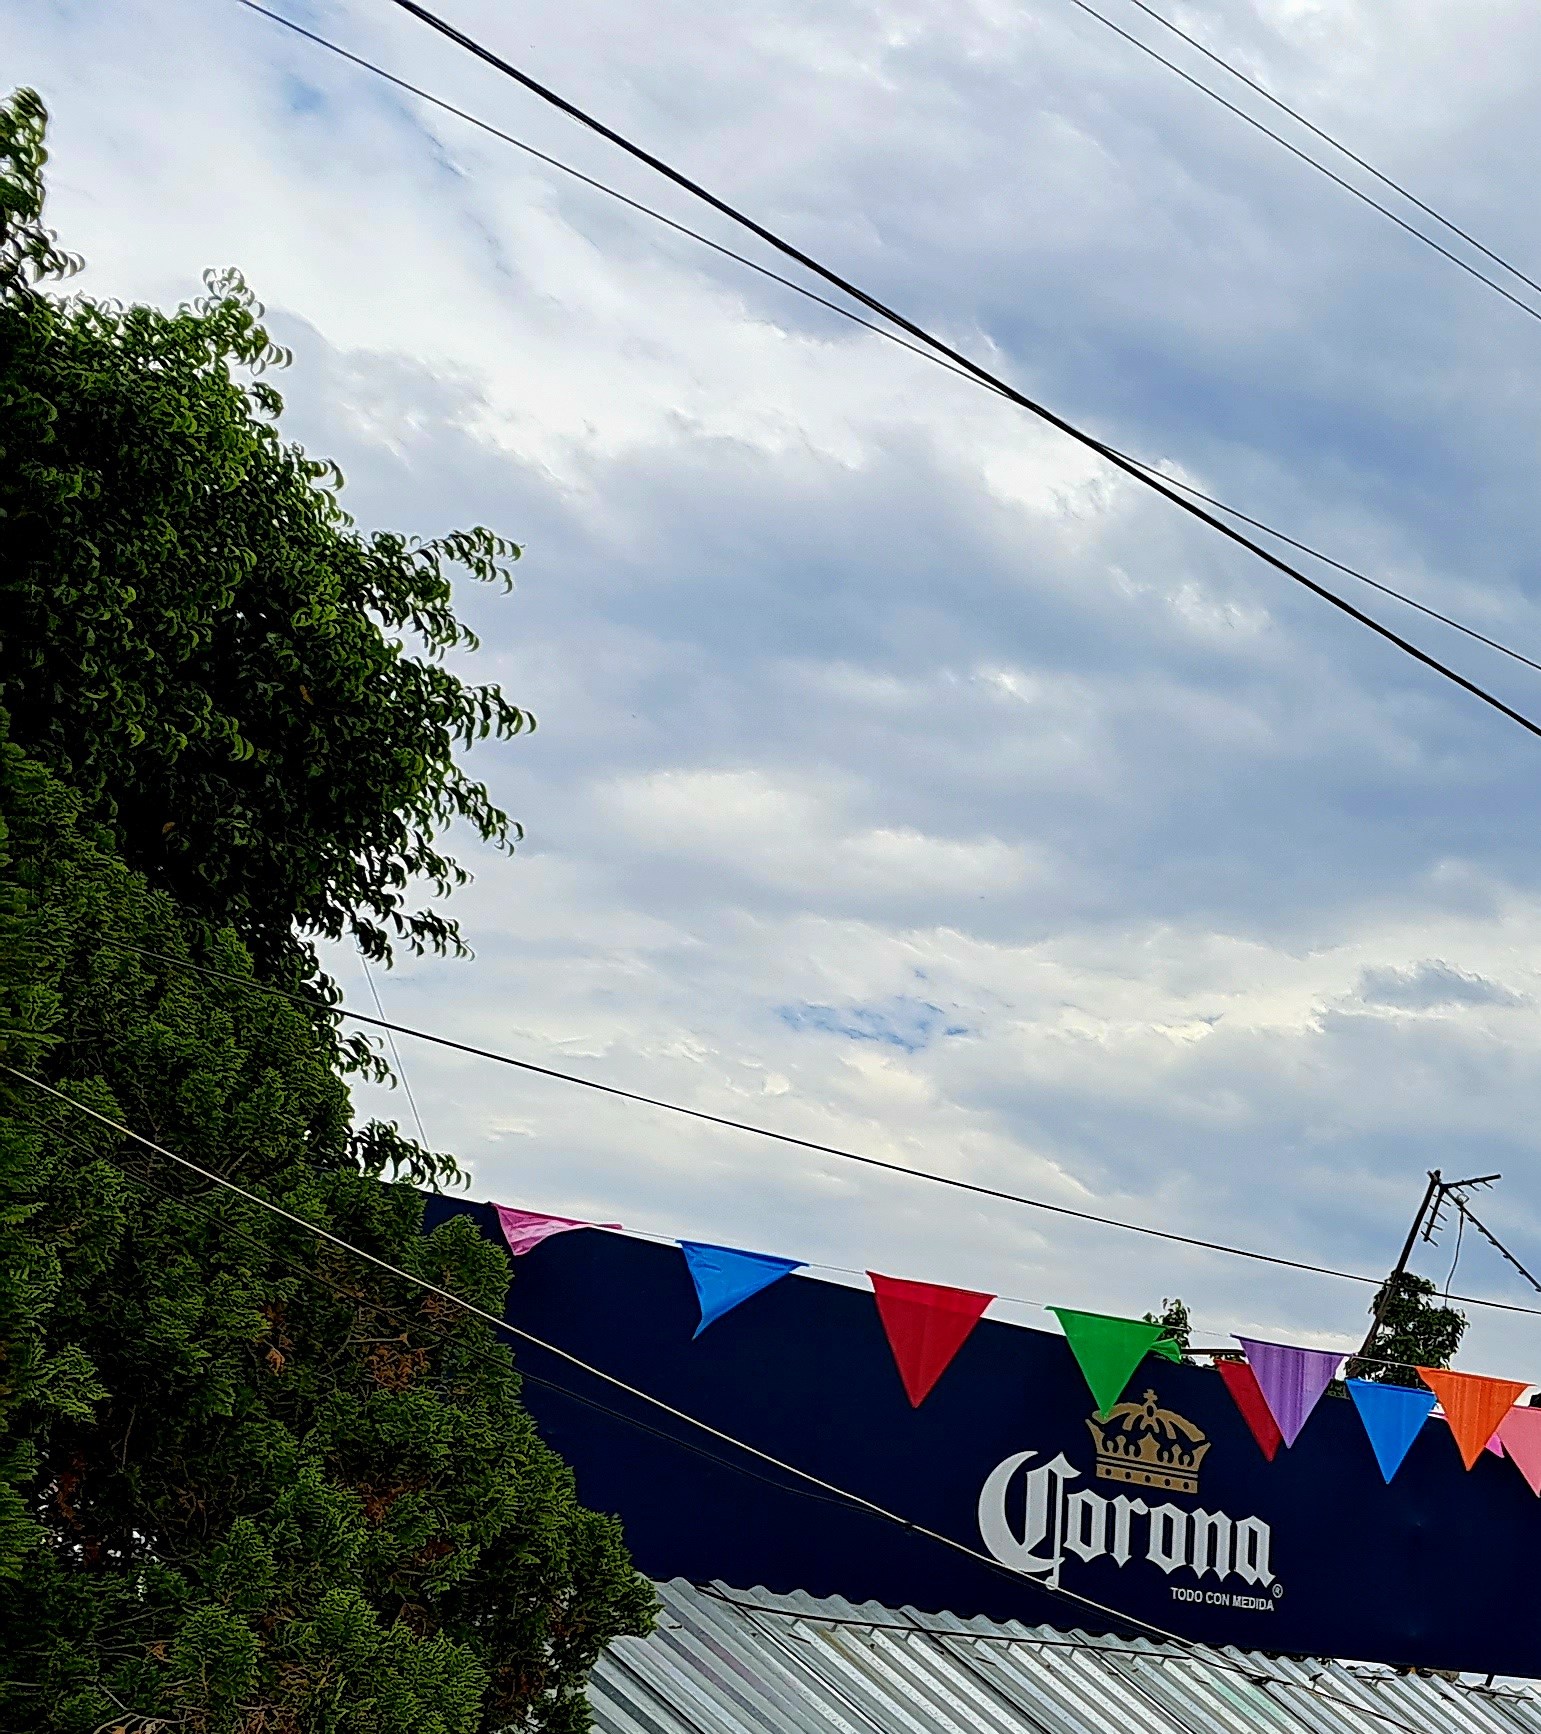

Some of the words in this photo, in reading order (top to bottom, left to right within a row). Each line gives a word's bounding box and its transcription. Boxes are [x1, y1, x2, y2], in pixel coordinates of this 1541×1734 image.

[978, 1451, 1276, 1590] Corona
[1170, 1587, 1203, 1602] TODO
[1206, 1592, 1230, 1606] CON
[1232, 1595, 1274, 1611] MEDIDA
